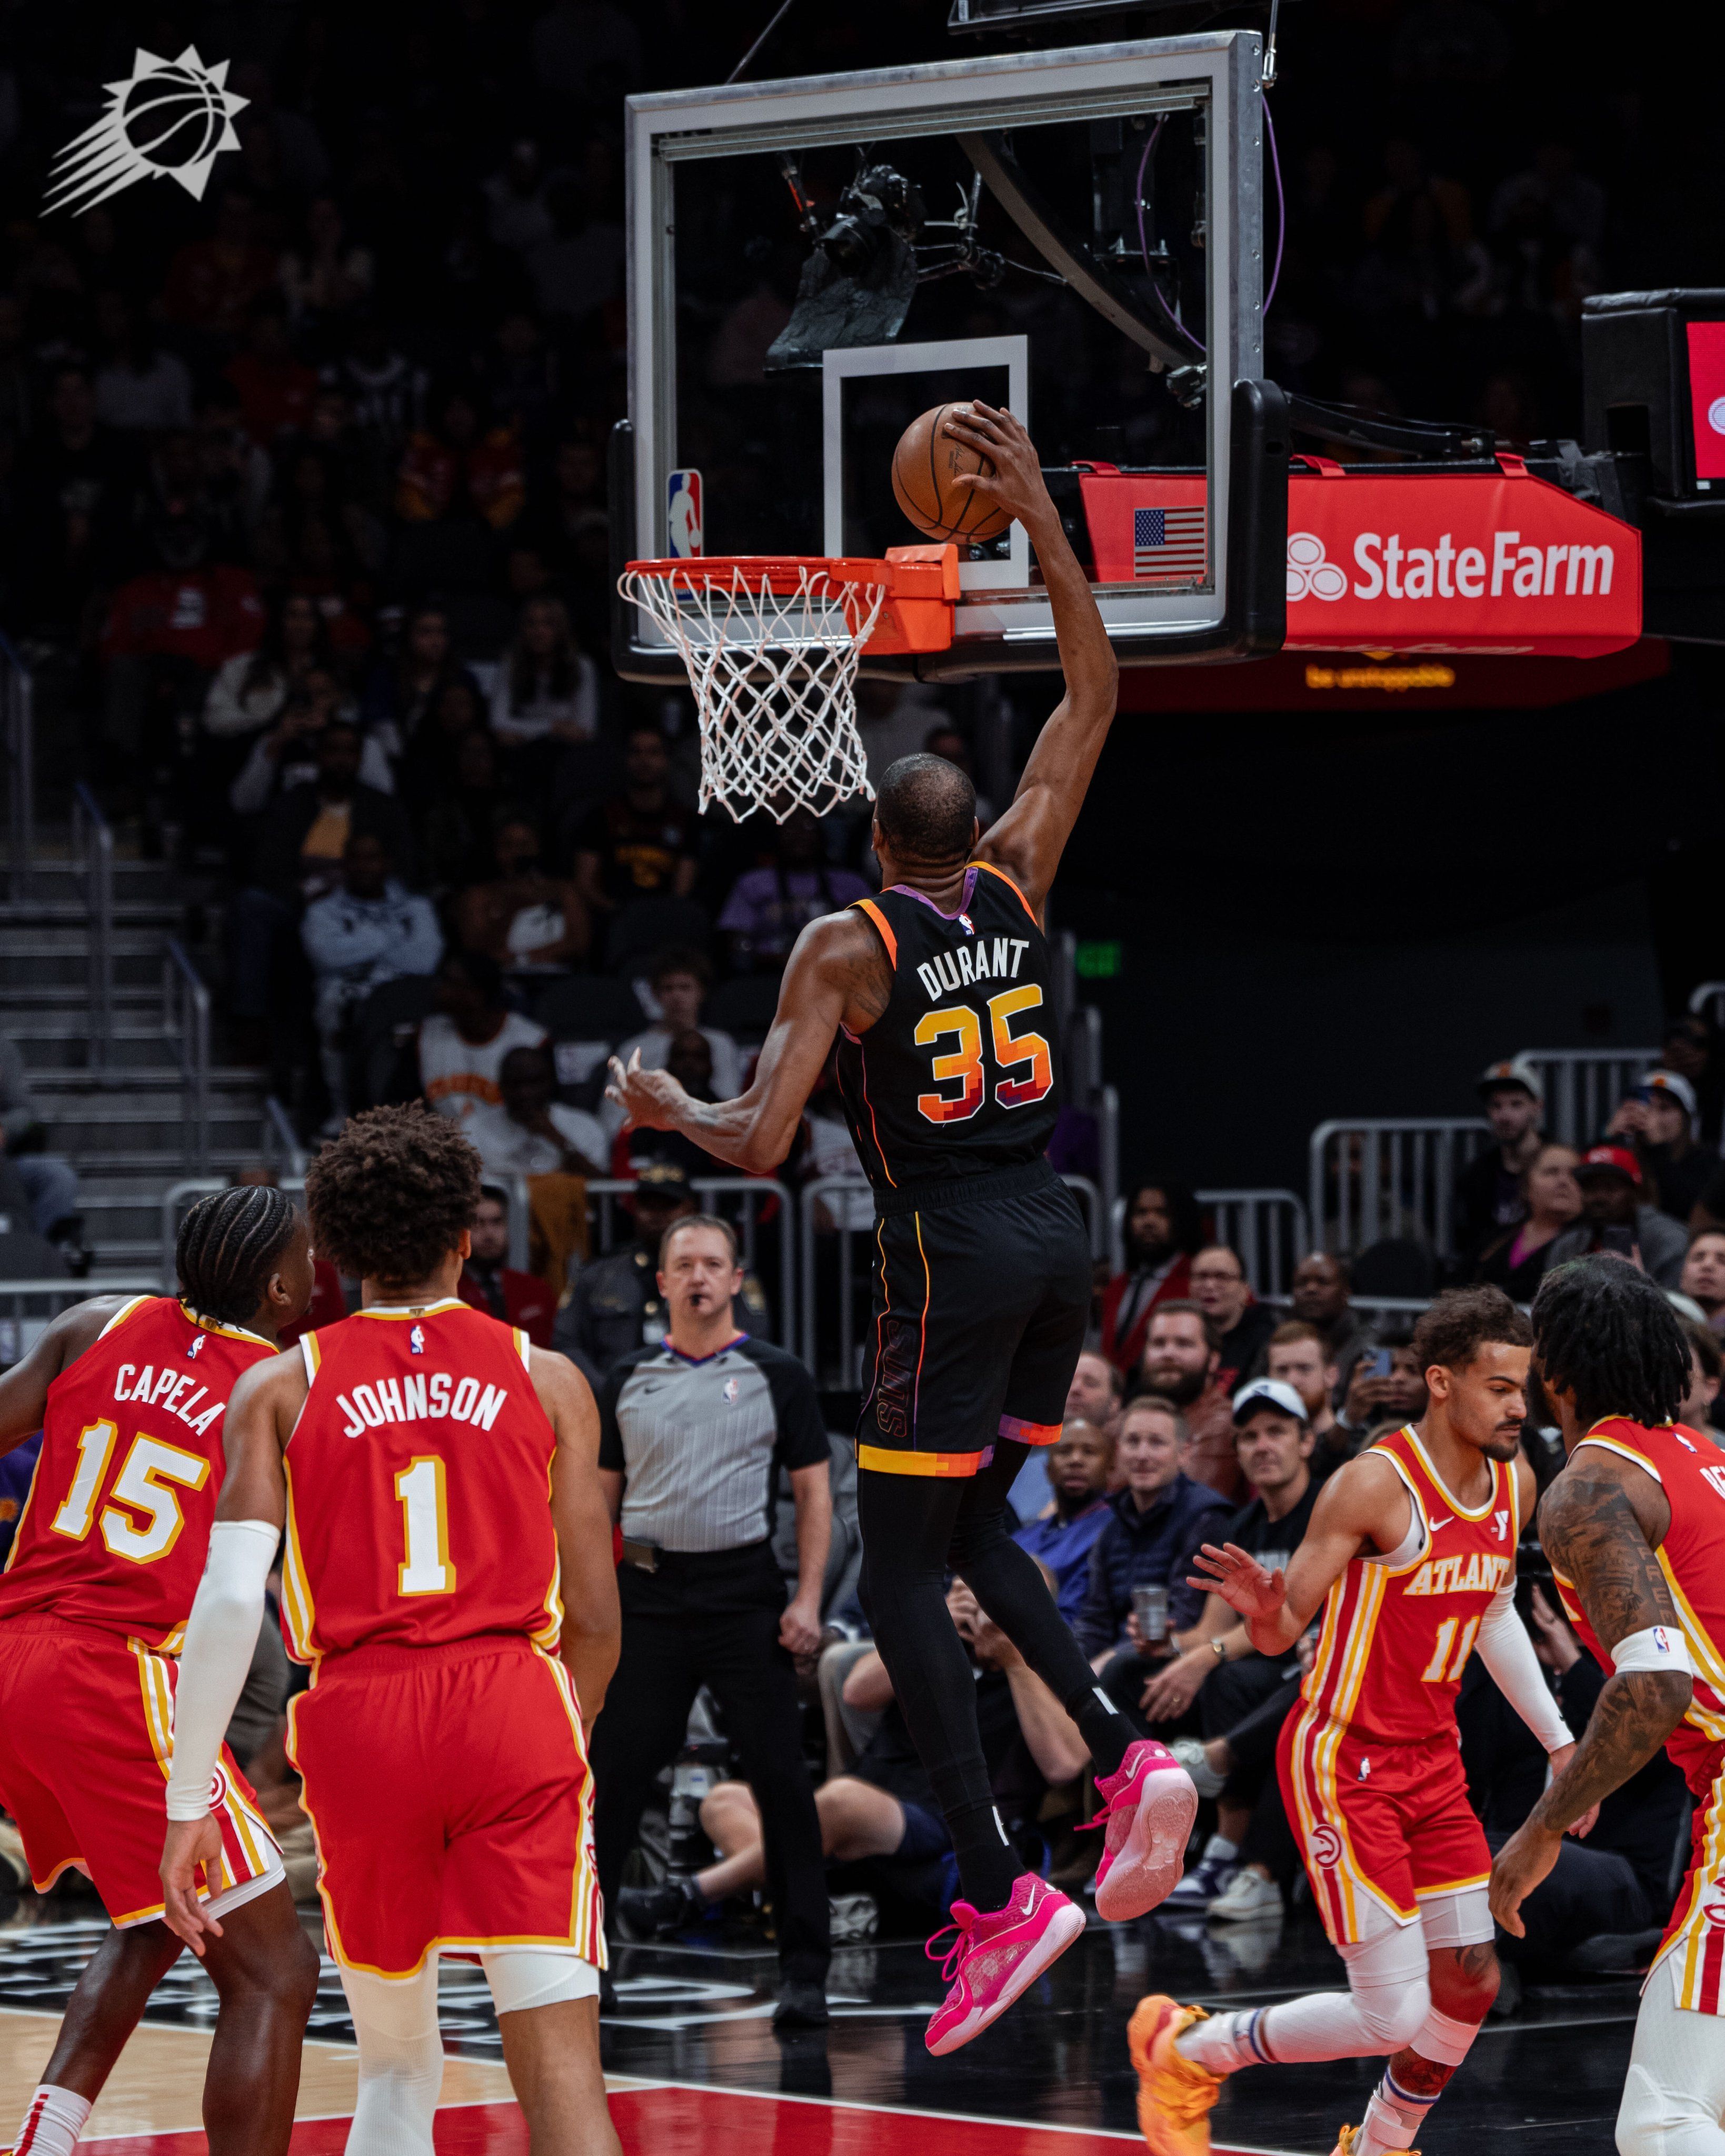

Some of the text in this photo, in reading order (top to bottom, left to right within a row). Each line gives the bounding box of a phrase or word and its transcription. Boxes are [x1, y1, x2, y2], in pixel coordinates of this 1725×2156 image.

[916, 937, 1029, 1001] DURANT
[914, 983, 1053, 1123] 35
[114, 1364, 226, 1436] CAPELA
[336, 1373, 507, 1438] JOHNSON
[49, 1417, 210, 1565] 15
[1699, 1465, 1725, 1500] BE
[394, 1455, 456, 1596] 1
[1402, 1553, 1511, 1595] ATLANT
[1420, 1615, 1480, 1683] 11
